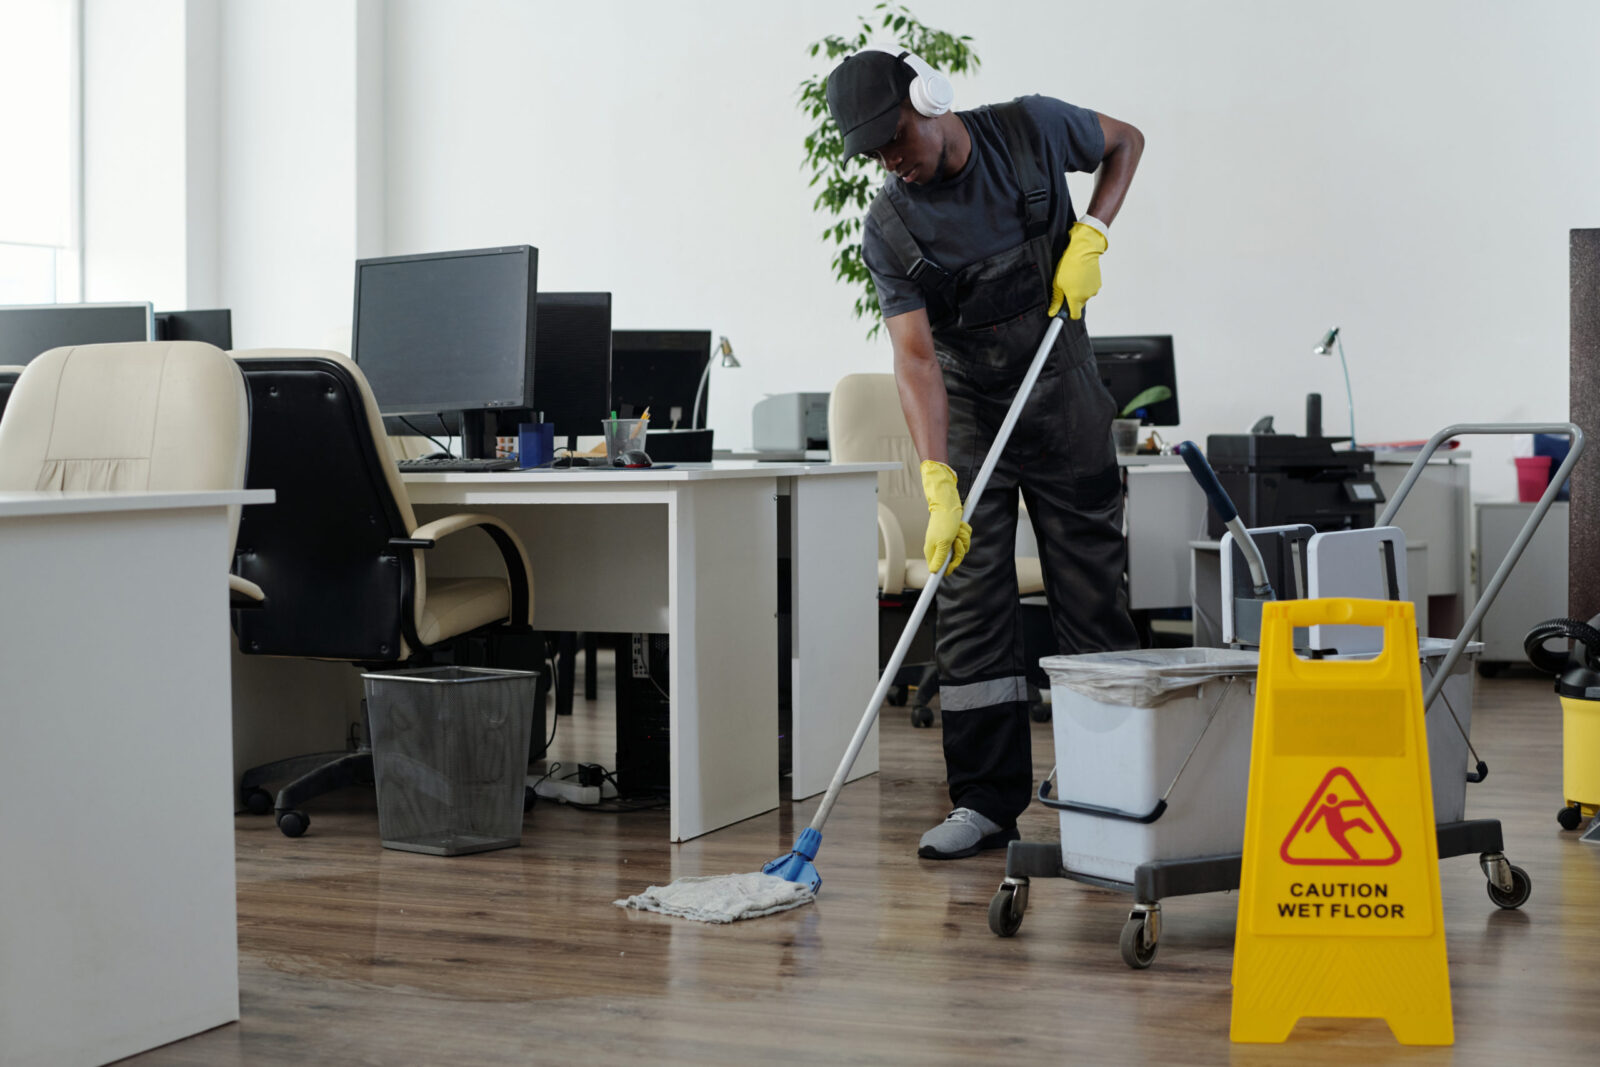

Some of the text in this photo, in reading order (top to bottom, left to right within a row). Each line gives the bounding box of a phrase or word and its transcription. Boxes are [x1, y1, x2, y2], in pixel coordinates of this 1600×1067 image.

[1289, 882, 1388, 898] CAUTION
[1277, 902, 1405, 919] WET FLOOR
